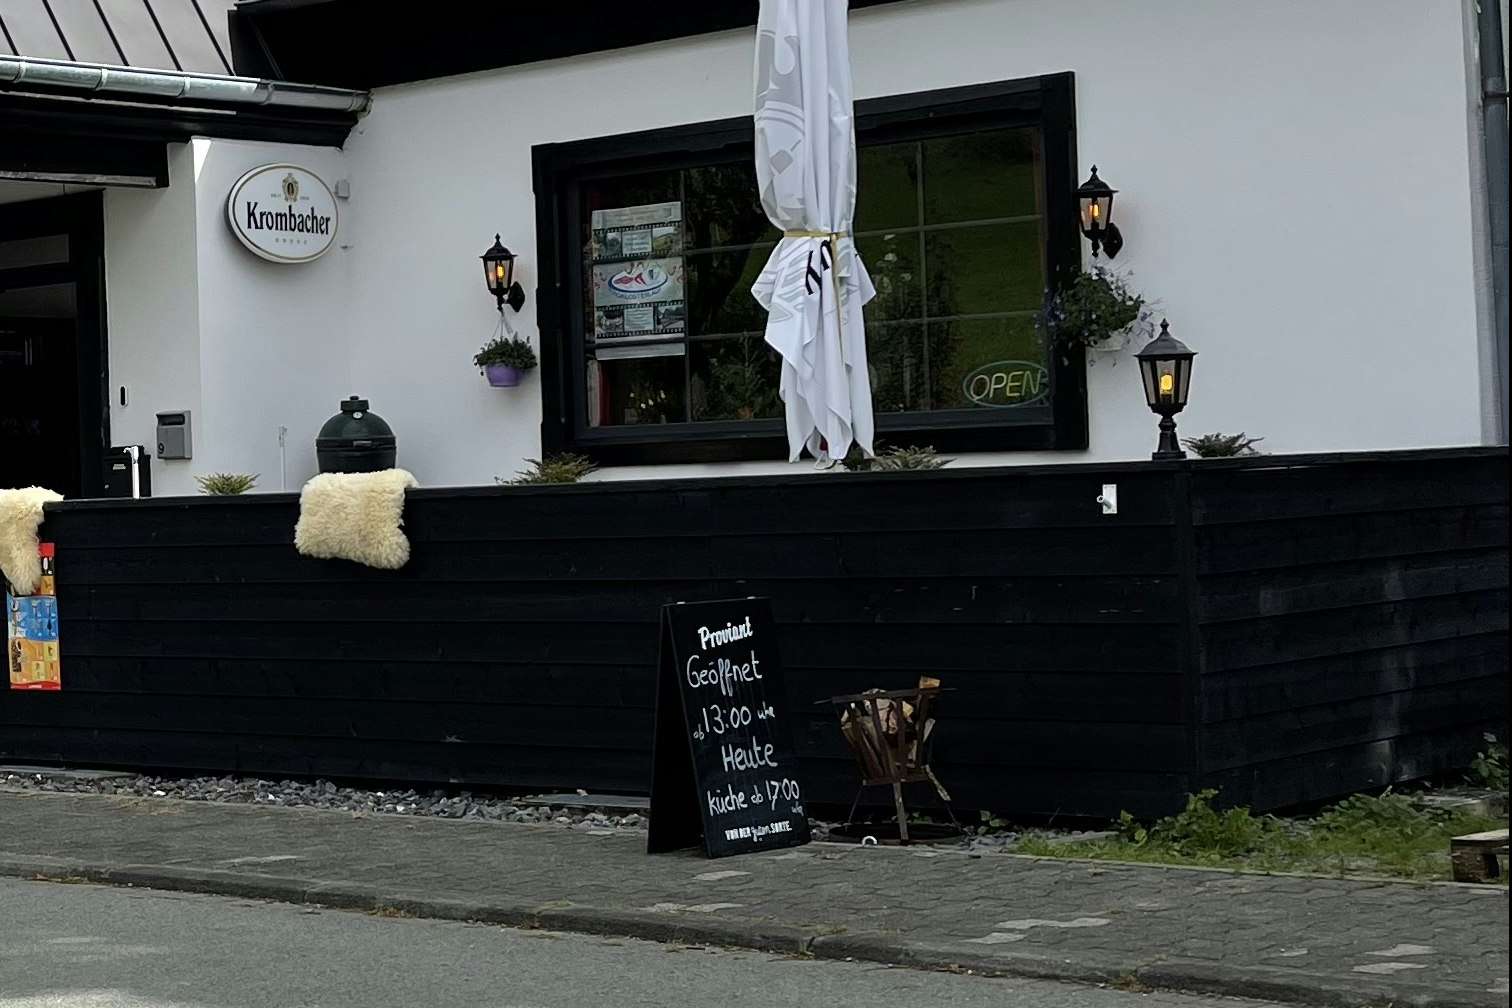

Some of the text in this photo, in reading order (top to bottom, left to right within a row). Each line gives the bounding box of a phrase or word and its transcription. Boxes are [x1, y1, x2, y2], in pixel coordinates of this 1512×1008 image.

[246, 201, 332, 236] Krombacher
[970, 370, 1042, 401] OPEN
[157, 442, 165, 454] 9
[697, 615, 754, 650] Proviant
[686, 650, 763, 697] Geöffnet
[693, 723, 705, 741] ab
[702, 704, 752, 735] 13:00
[721, 736, 778, 772] Heute
[751, 784, 764, 805] ab
[765, 778, 800, 811] 17:00
